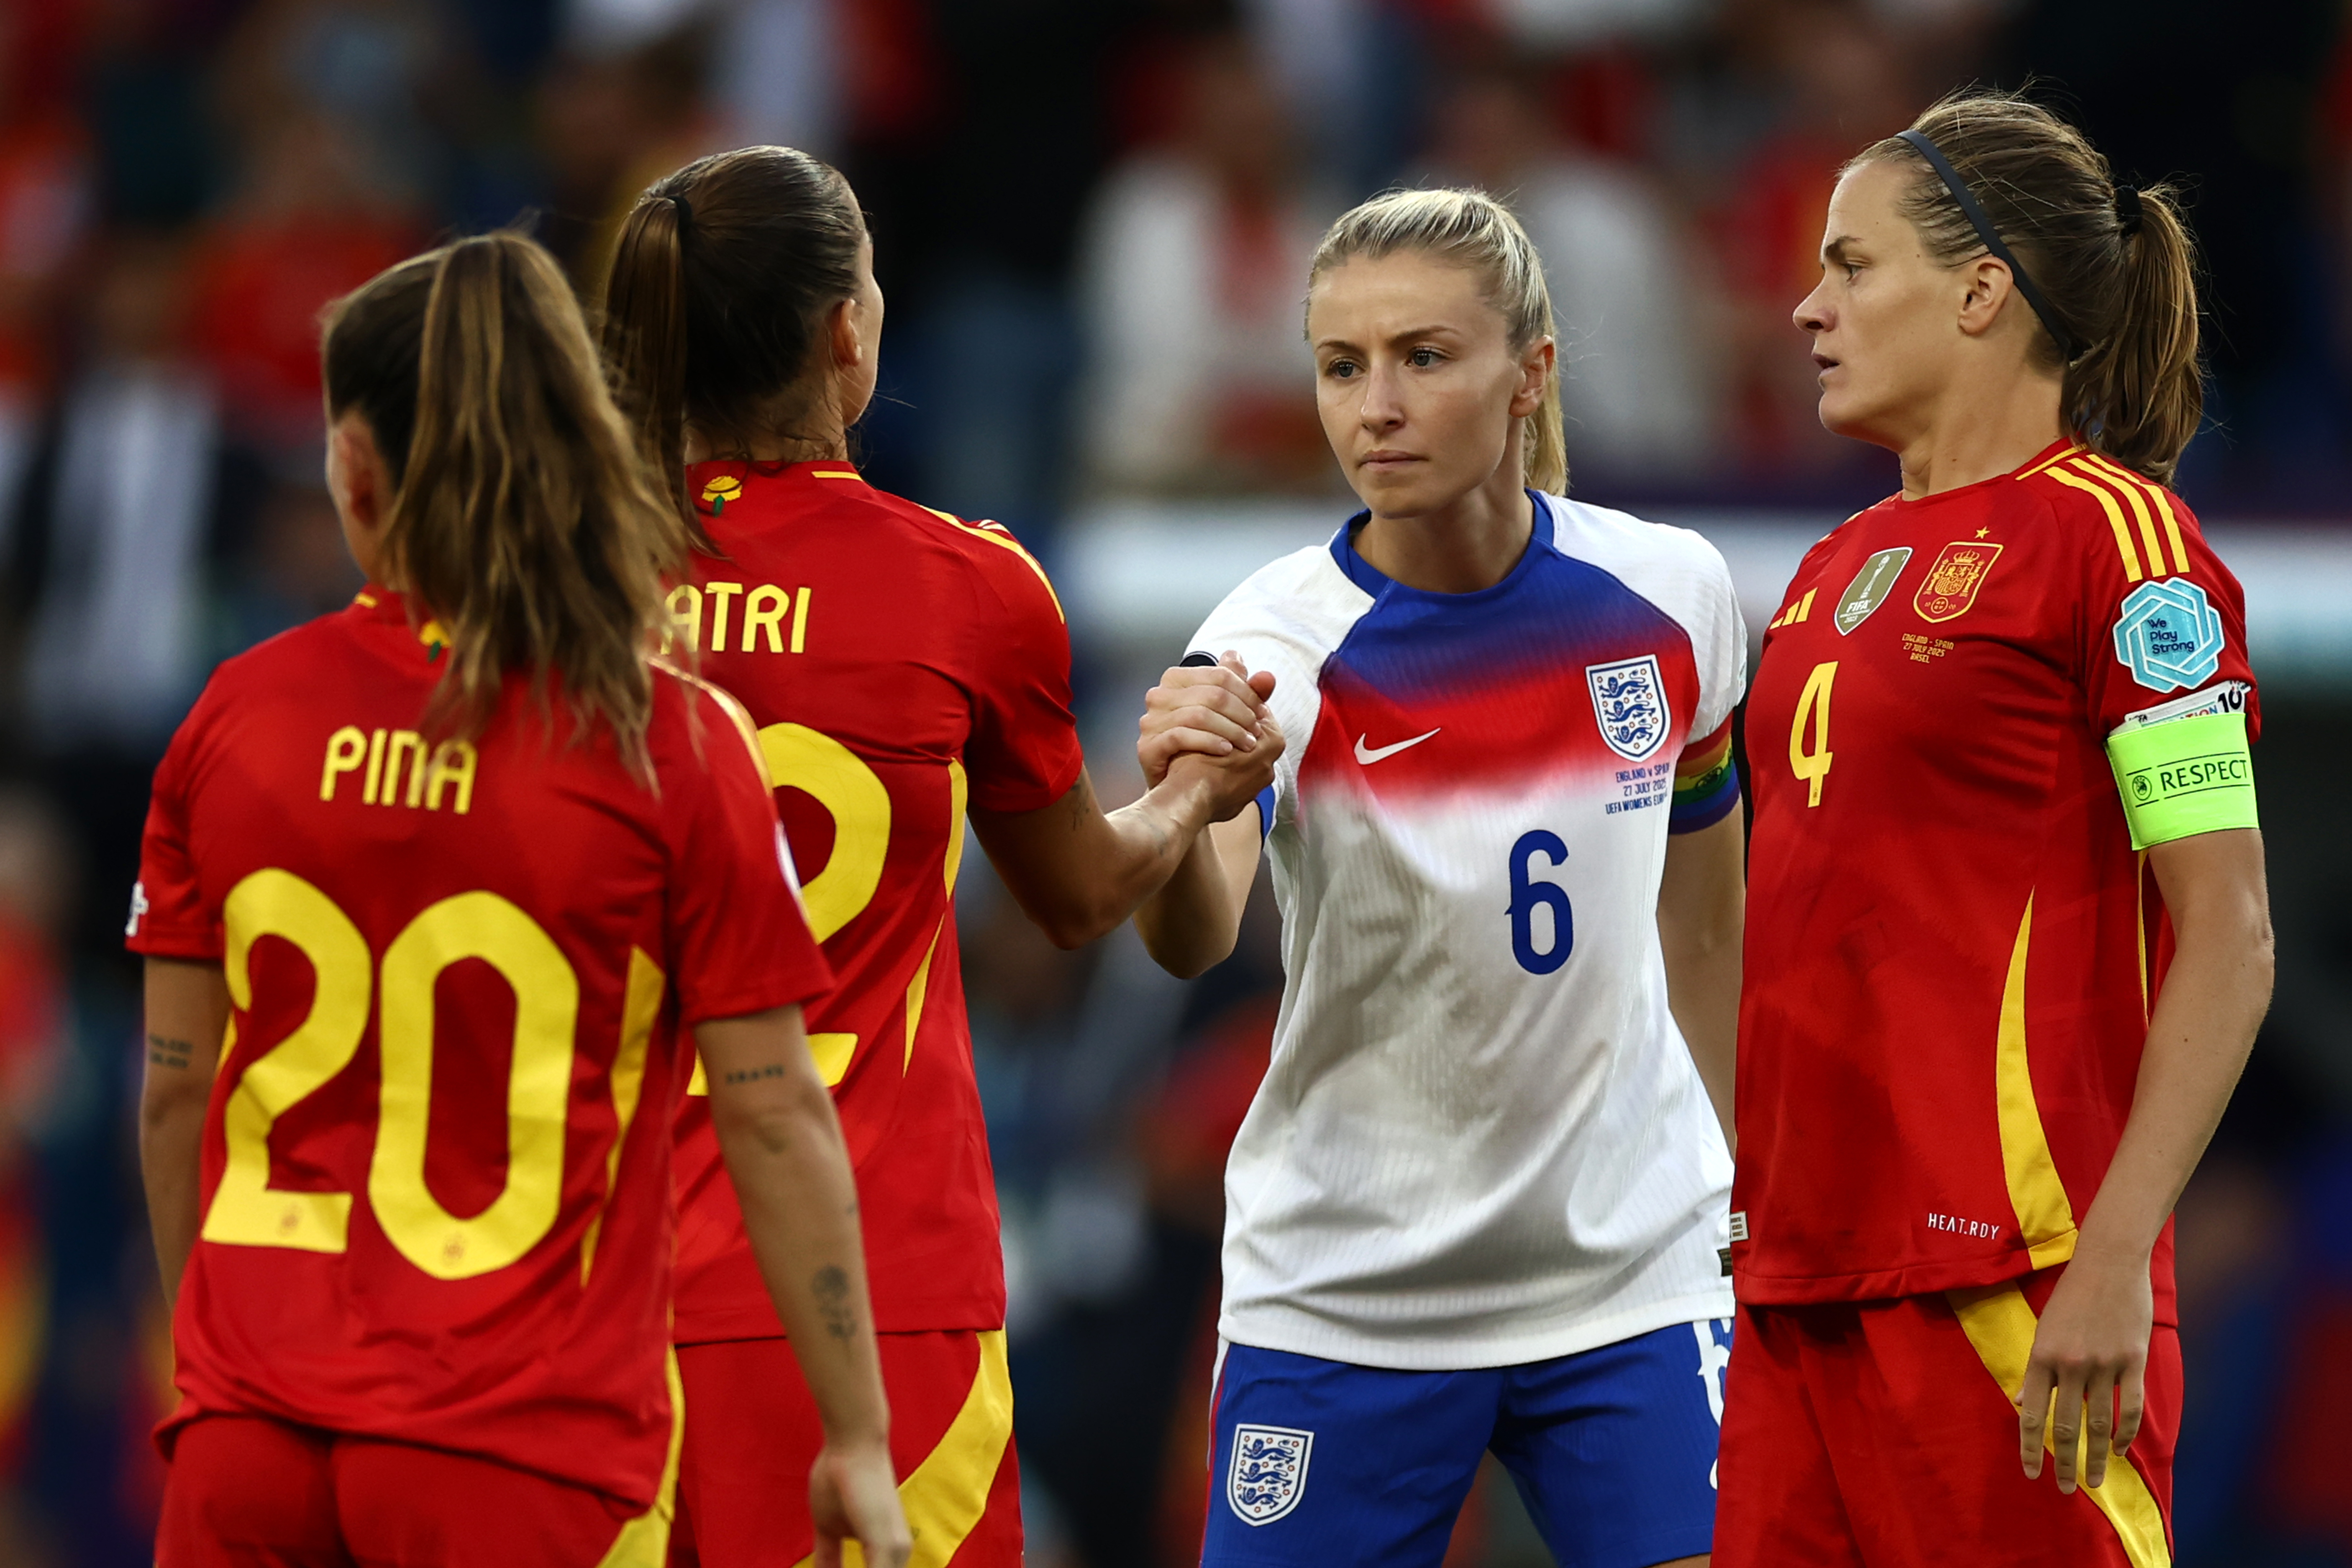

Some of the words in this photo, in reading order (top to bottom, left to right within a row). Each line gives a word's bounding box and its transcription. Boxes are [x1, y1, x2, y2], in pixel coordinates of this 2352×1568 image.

[1846, 600, 1869, 613] FIFA
[660, 581, 811, 655] ATRI
[2147, 618, 2167, 628] We
[1901, 633, 1928, 645] ENGLAND
[1934, 638, 1955, 650] SPAIN
[2150, 630, 2178, 642] Play
[1911, 644, 1928, 653] JULY
[1927, 646, 1946, 657] 2025
[2152, 641, 2195, 655] Strong
[1909, 652, 1930, 664] BASEL
[2218, 688, 2242, 713] 10
[1789, 661, 1839, 808] 4
[319, 725, 478, 815] PINA
[1615, 768, 1646, 783] ENGLAND
[2160, 759, 2247, 792] RESPECT
[1623, 785, 1632, 797] 27
[1635, 781, 1651, 794] JULY
[1605, 802, 1622, 815] UEFA
[1622, 796, 1653, 811] WOMENS
[1504, 829, 1573, 976] 6
[200, 867, 580, 1281] 20
[1927, 1212, 2000, 1240] HEAT.RDY
